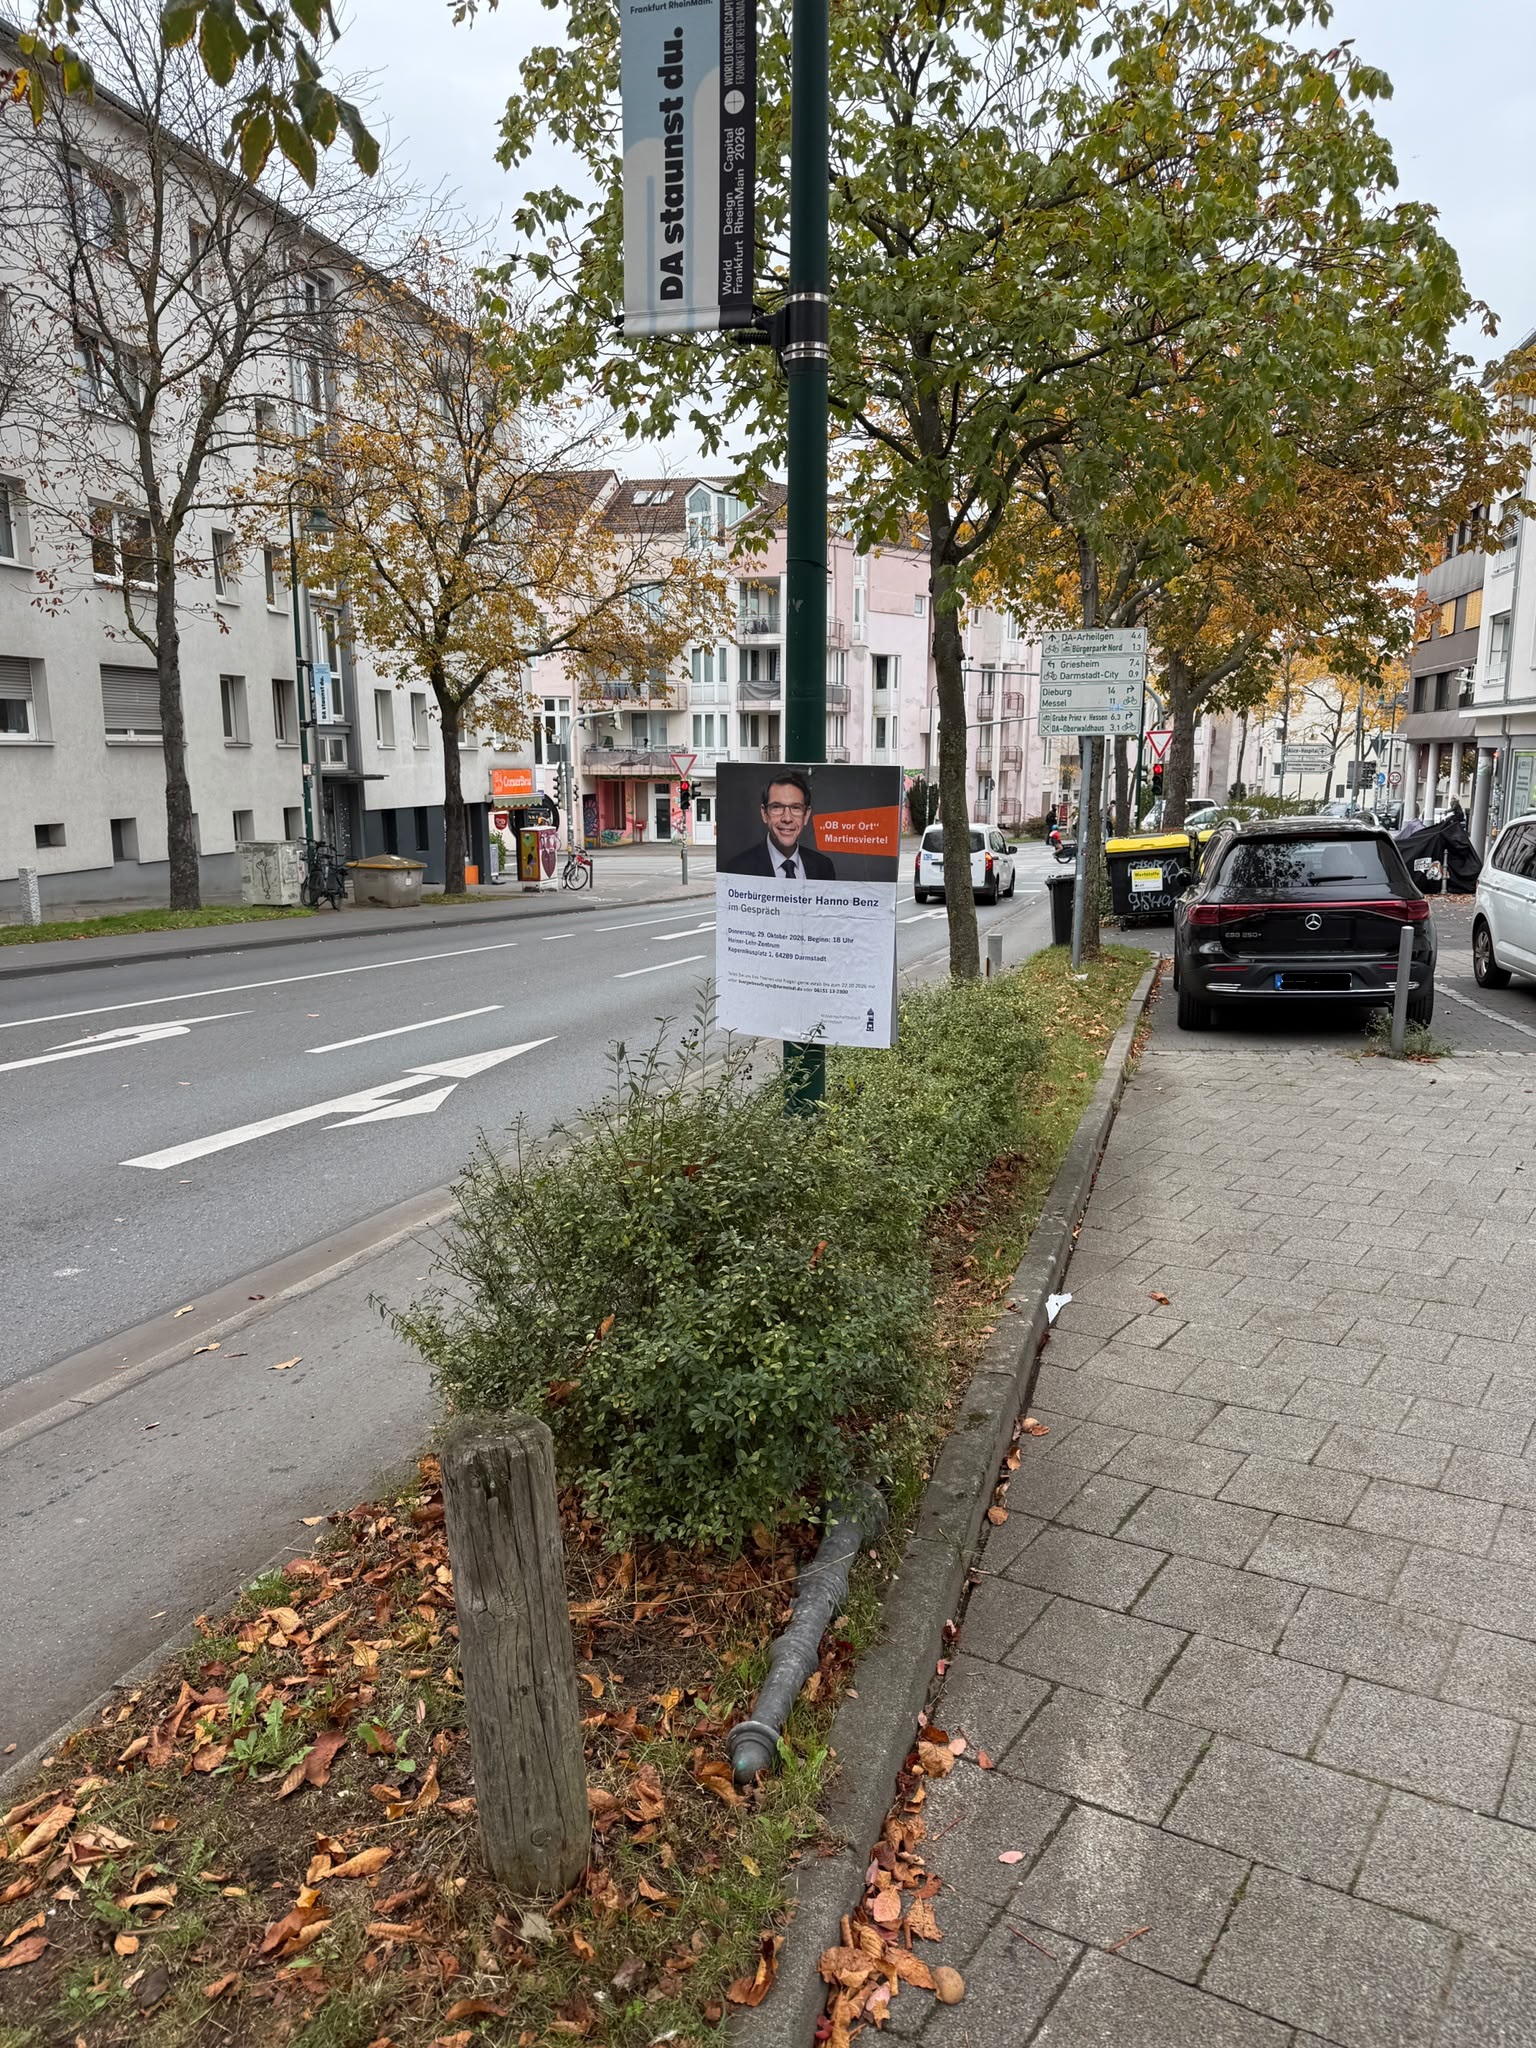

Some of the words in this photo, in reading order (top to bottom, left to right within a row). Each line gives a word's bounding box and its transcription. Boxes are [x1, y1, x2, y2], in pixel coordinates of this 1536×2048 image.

[630, 2, 667, 14] Frankfurt
[724, 24, 734, 54] DESIGN
[657, 26, 684, 90] du.
[736, 40, 745, 84] FRANKFURT
[724, 57, 734, 86] WORLD
[724, 128, 735, 172] Capital
[735, 127, 745, 160] 2026
[659, 96, 684, 244] staunst
[734, 168, 744, 234] RheinMain
[723, 192, 735, 235] Design
[660, 250, 684, 300] DA
[722, 259, 732, 295] World
[734, 240, 744, 294] Frankfurt
[1062, 633, 1114, 641] DA-Arheilgen
[1072, 644, 1106, 654] Bürgerpark
[1060, 660, 1099, 668] Griesheim
[1060, 671, 1119, 682] Darmstadt-City
[1042, 688, 1072, 697] Dieburg
[1052, 723, 1104, 732] DA-Oberwaldhaus
[825, 834, 888, 844] Martinsviertel
[728, 888, 812, 905] Oberbürgermeister
[816, 896, 849, 906] Hanno
[853, 897, 879, 907] Benz
[728, 902, 738, 911] im
[740, 903, 780, 916] Gespräch
[767, 931, 788, 940] Oktober
[794, 953, 826, 962] Darmstadt
